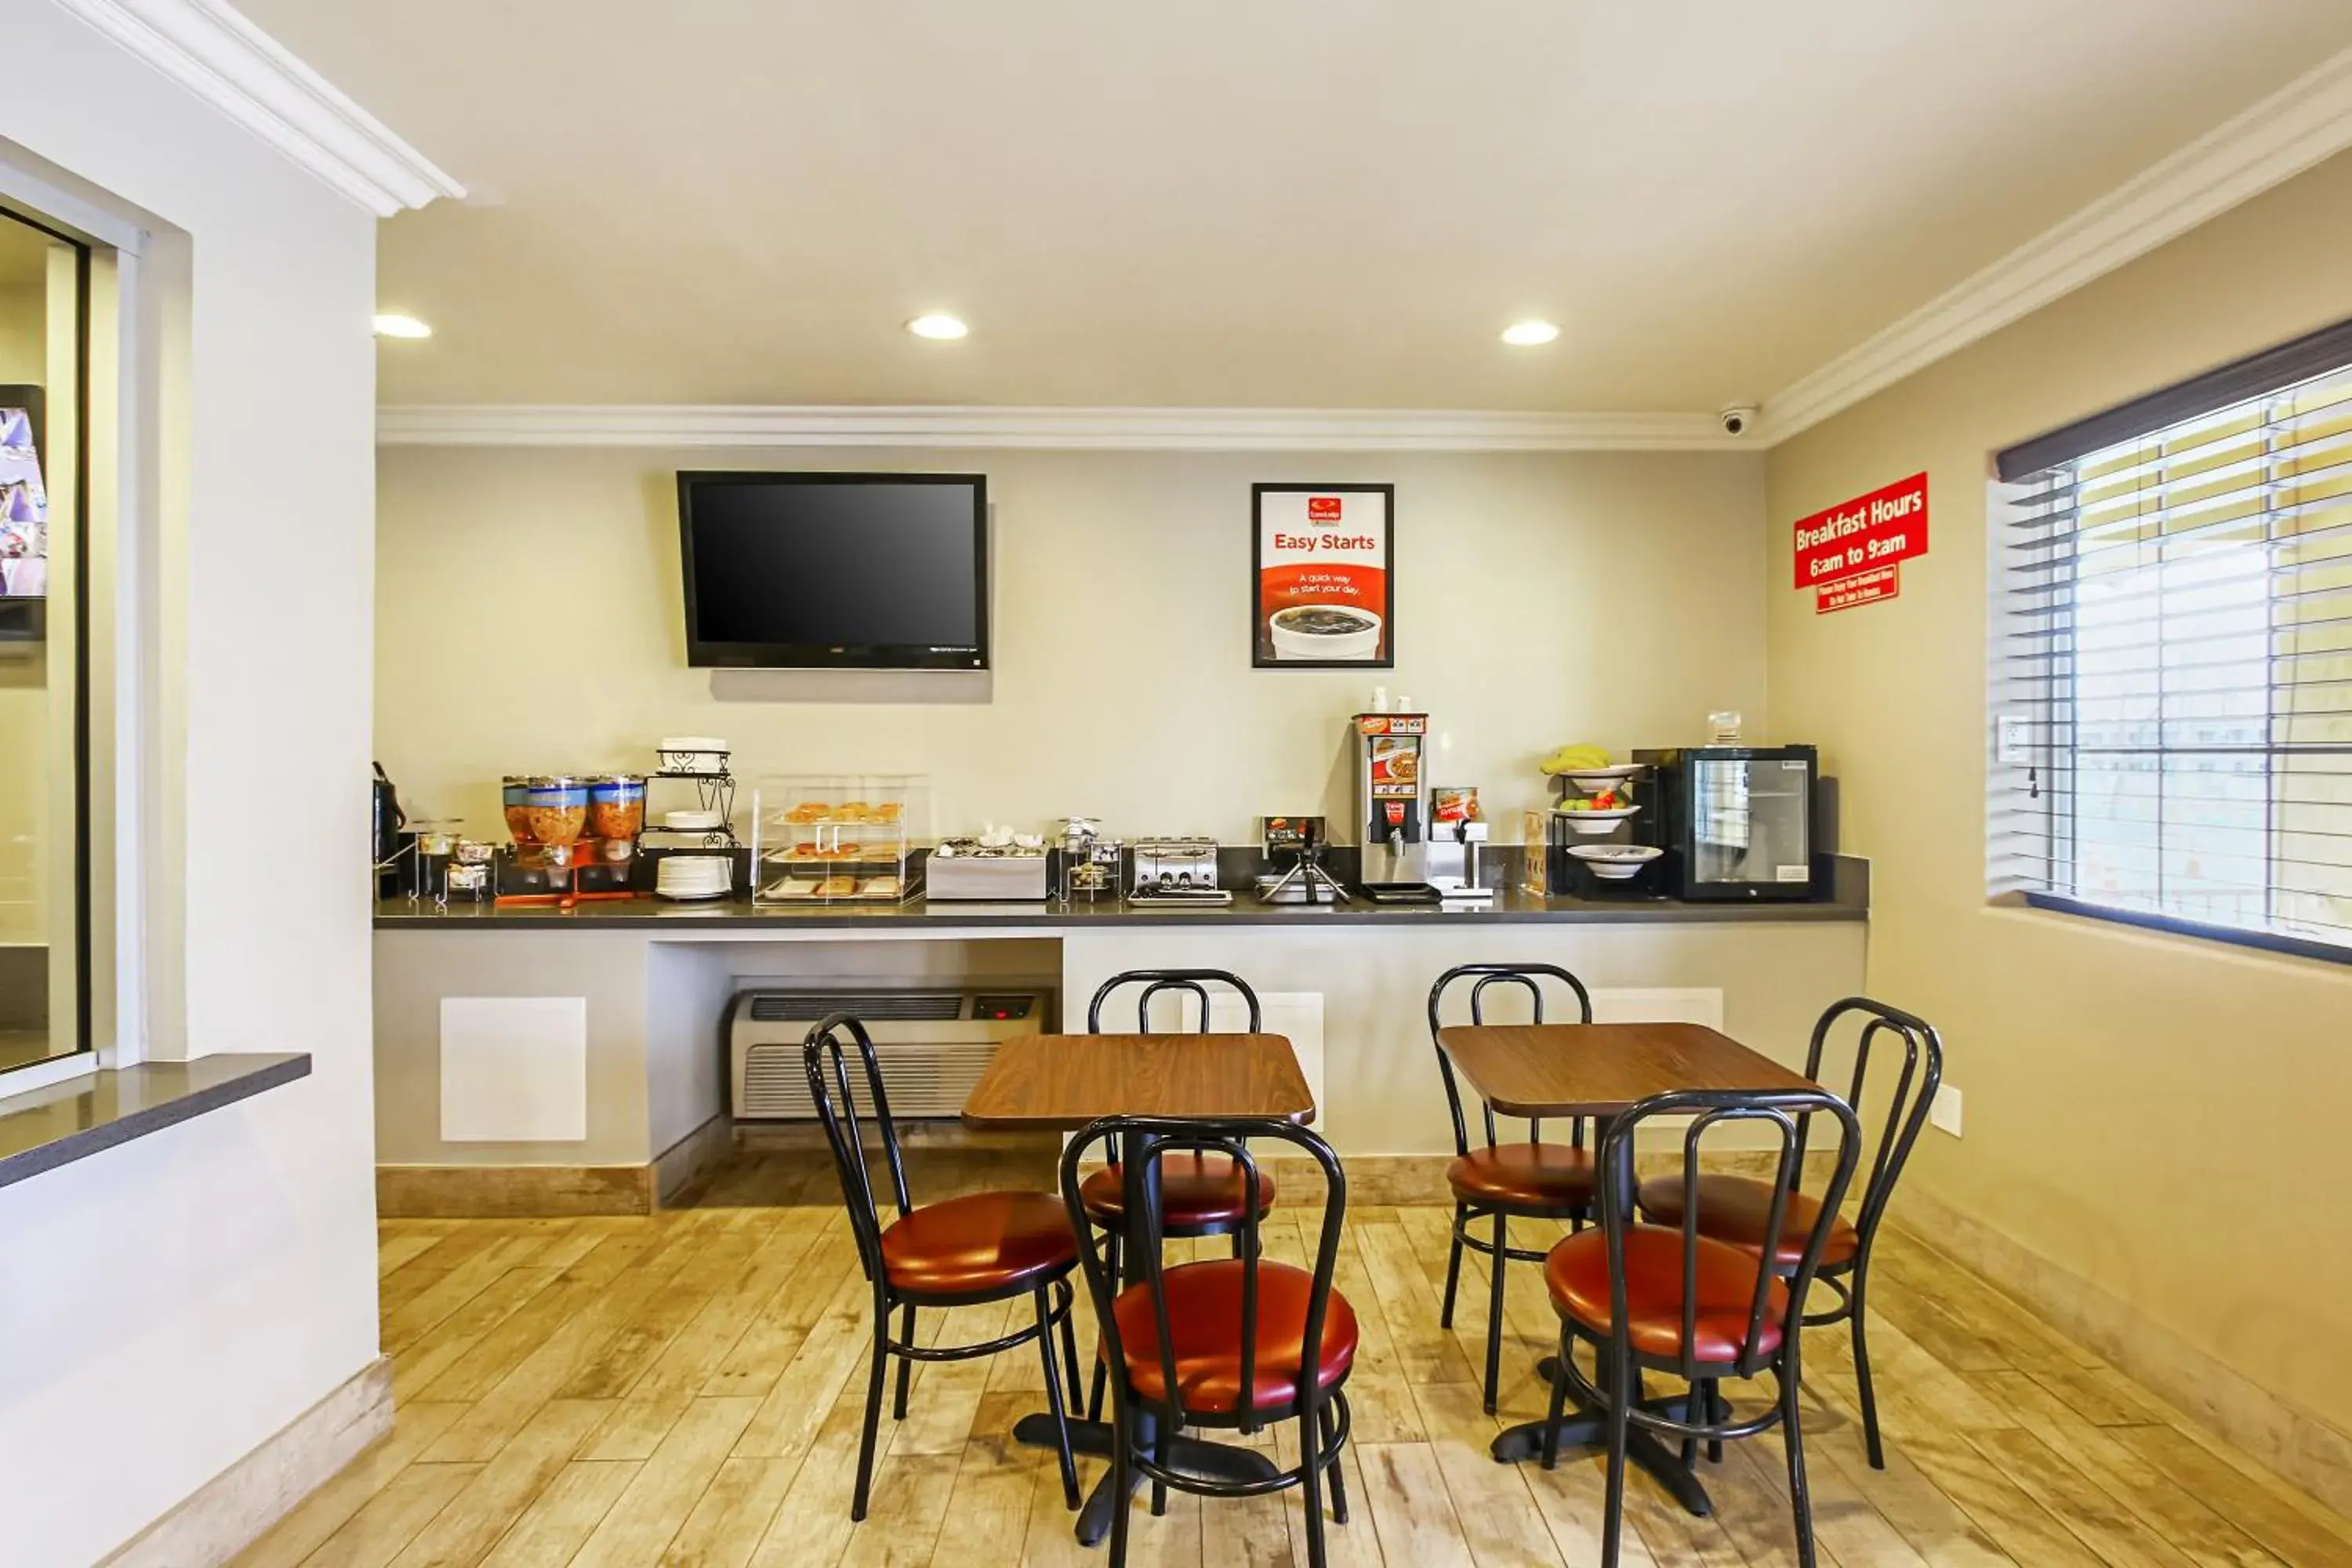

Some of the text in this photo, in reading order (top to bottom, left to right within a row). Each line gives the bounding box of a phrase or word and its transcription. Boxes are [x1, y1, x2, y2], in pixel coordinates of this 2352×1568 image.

[1796, 490, 1922, 552] Breakfast Hours
[1275, 534, 1375, 552] Easy Starts
[1809, 534, 1906, 577] 6:am to 9:am
[1299, 573, 1307, 583] A
[1333, 575, 1350, 584] way
[1301, 585, 1320, 593] start
